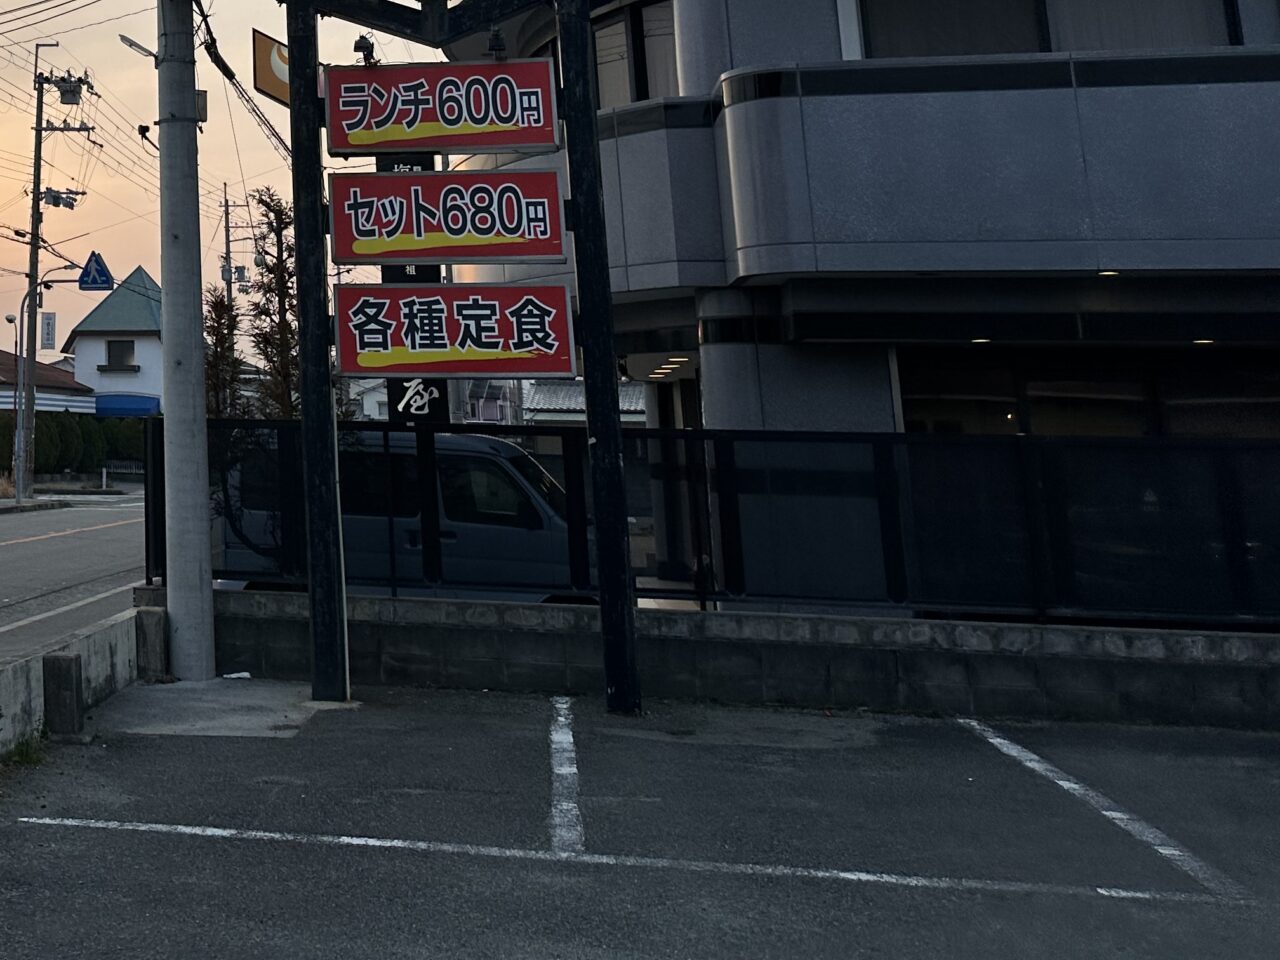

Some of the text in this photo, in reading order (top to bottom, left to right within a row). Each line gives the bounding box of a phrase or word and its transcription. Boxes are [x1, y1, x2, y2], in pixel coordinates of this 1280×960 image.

[339, 76, 543, 132] ランチ600円
[345, 184, 551, 240] セット680円
[348, 296, 558, 354] 各種定食
